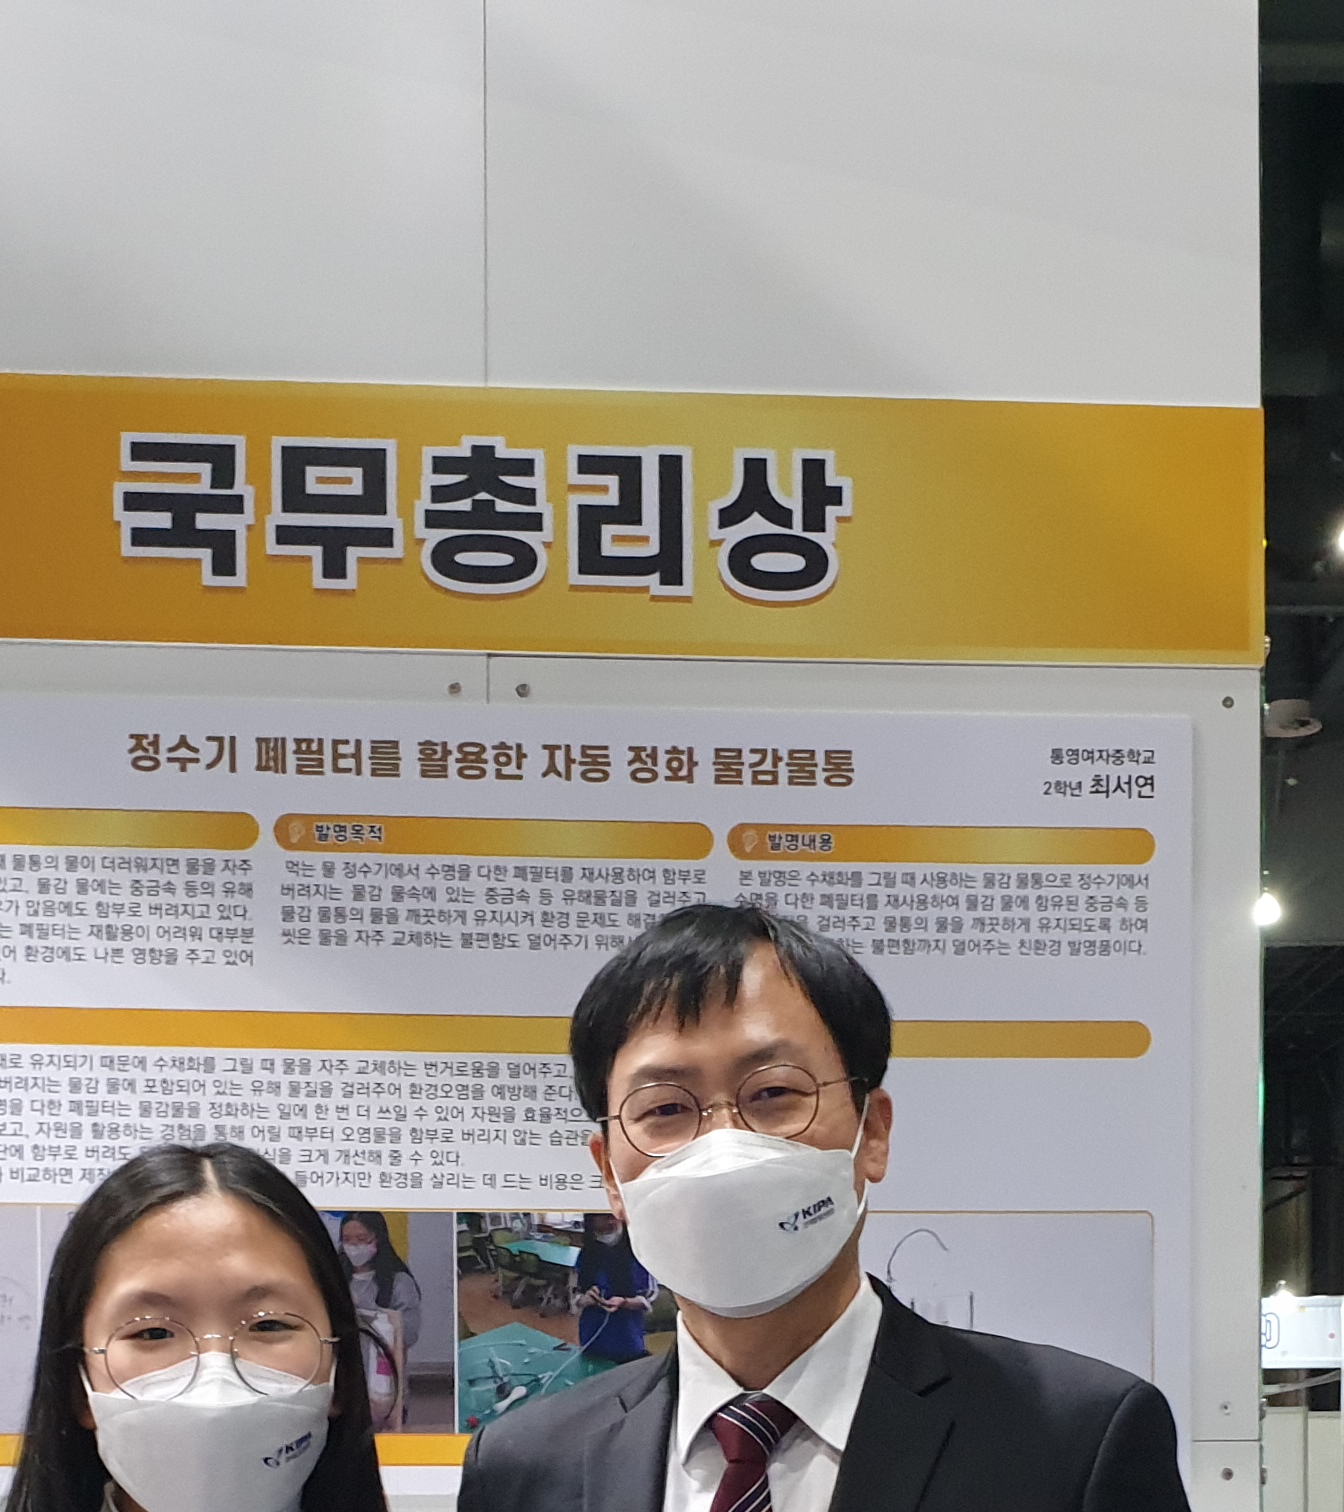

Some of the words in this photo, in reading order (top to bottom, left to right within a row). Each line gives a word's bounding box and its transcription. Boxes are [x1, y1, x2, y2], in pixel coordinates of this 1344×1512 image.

[113, 431, 853, 601] 국무총리상
[128, 733, 237, 774] 정수기
[255, 736, 402, 778] 폐필터를
[418, 740, 528, 782] 활용한
[541, 743, 612, 783] 자동
[627, 745, 699, 785] 정화
[712, 747, 855, 788] 물감물통
[1050, 748, 1156, 766] 통영여자중학교
[1043, 780, 1082, 797] 2학년
[1089, 774, 1155, 799] 최서연
[315, 824, 383, 843] 발명목적
[768, 833, 833, 852] 발명내용
